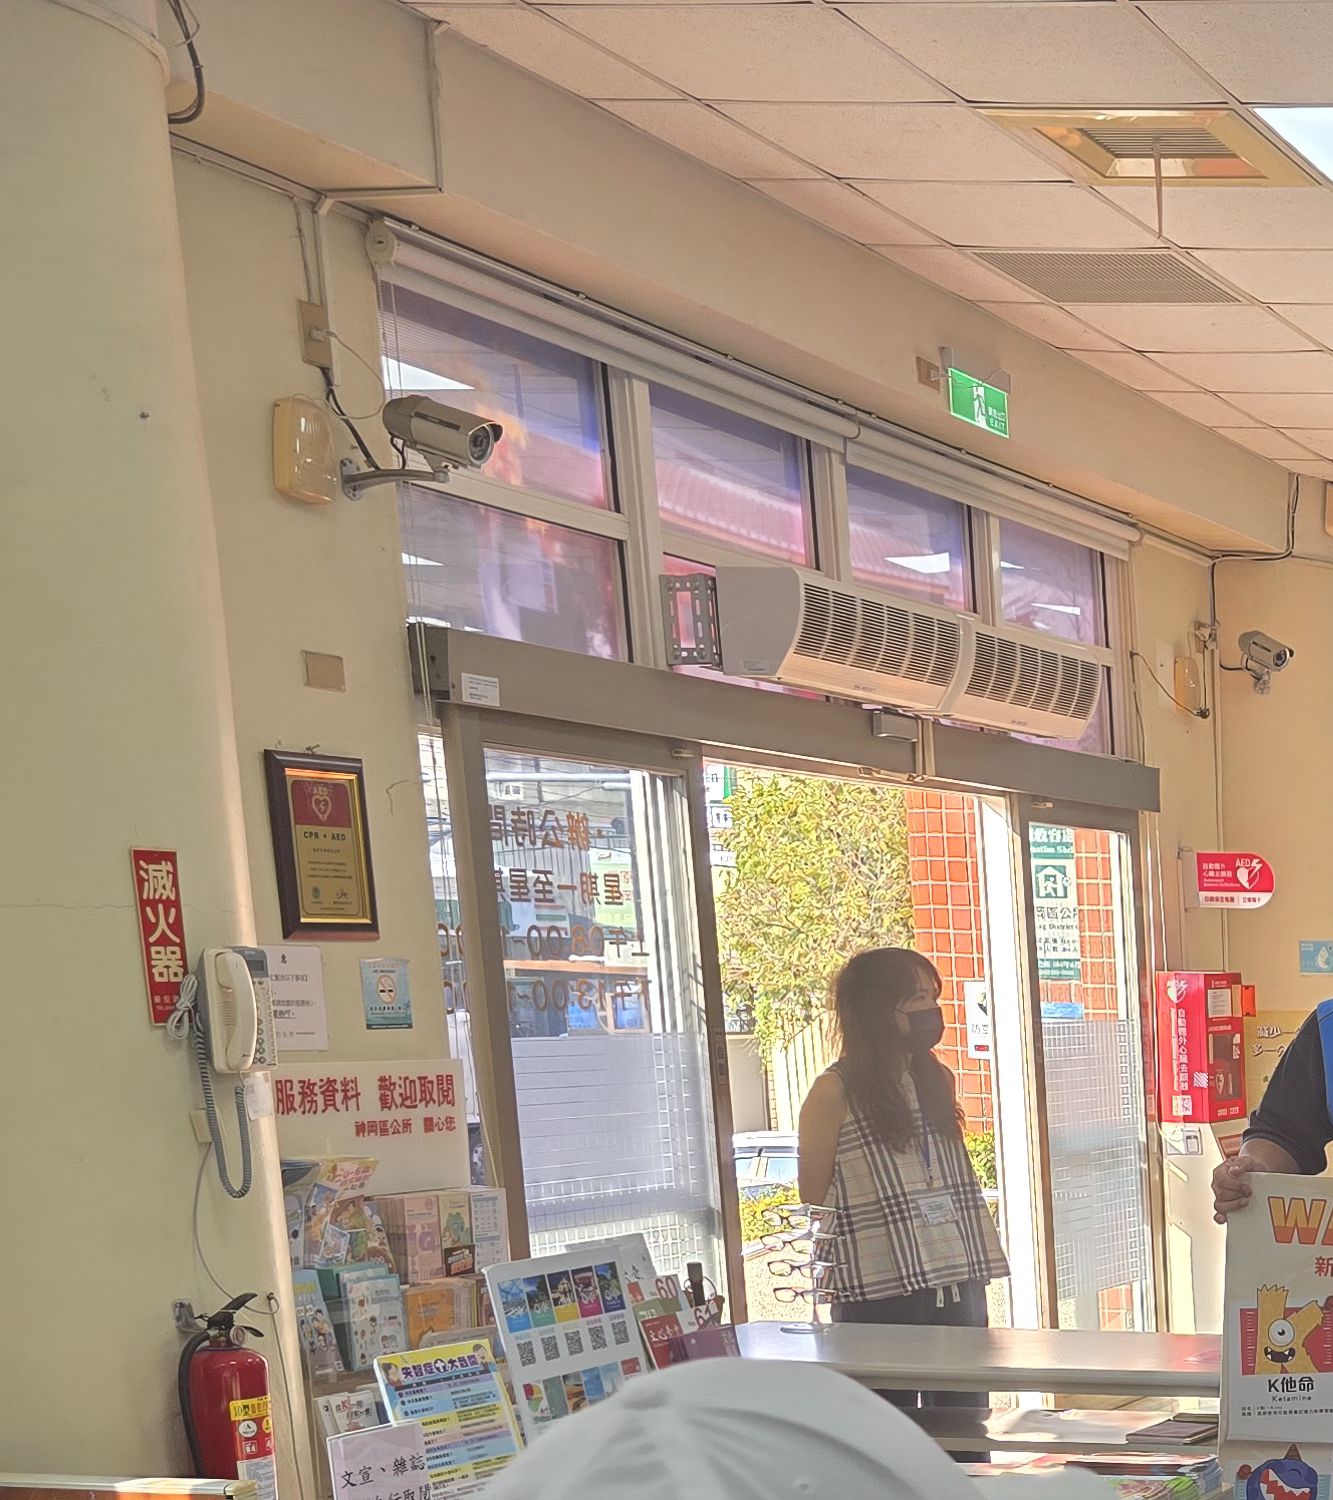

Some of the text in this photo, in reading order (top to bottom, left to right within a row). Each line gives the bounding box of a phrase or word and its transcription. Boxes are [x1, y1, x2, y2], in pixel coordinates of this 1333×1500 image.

[303, 830, 320, 841] CPR
[331, 832, 347, 842] AED
[1235, 858, 1251, 868] AED
[138, 860, 184, 984] 滅火器
[275, 1074, 456, 1116] 服務資料 歡迎取閱
[354, 1118, 413, 1138] 神岡區公所
[1267, 1376, 1315, 1393] K他命
[1271, 1394, 1312, 1402] Ketamine
[340, 1453, 426, 1489] 文宣、雜誌
